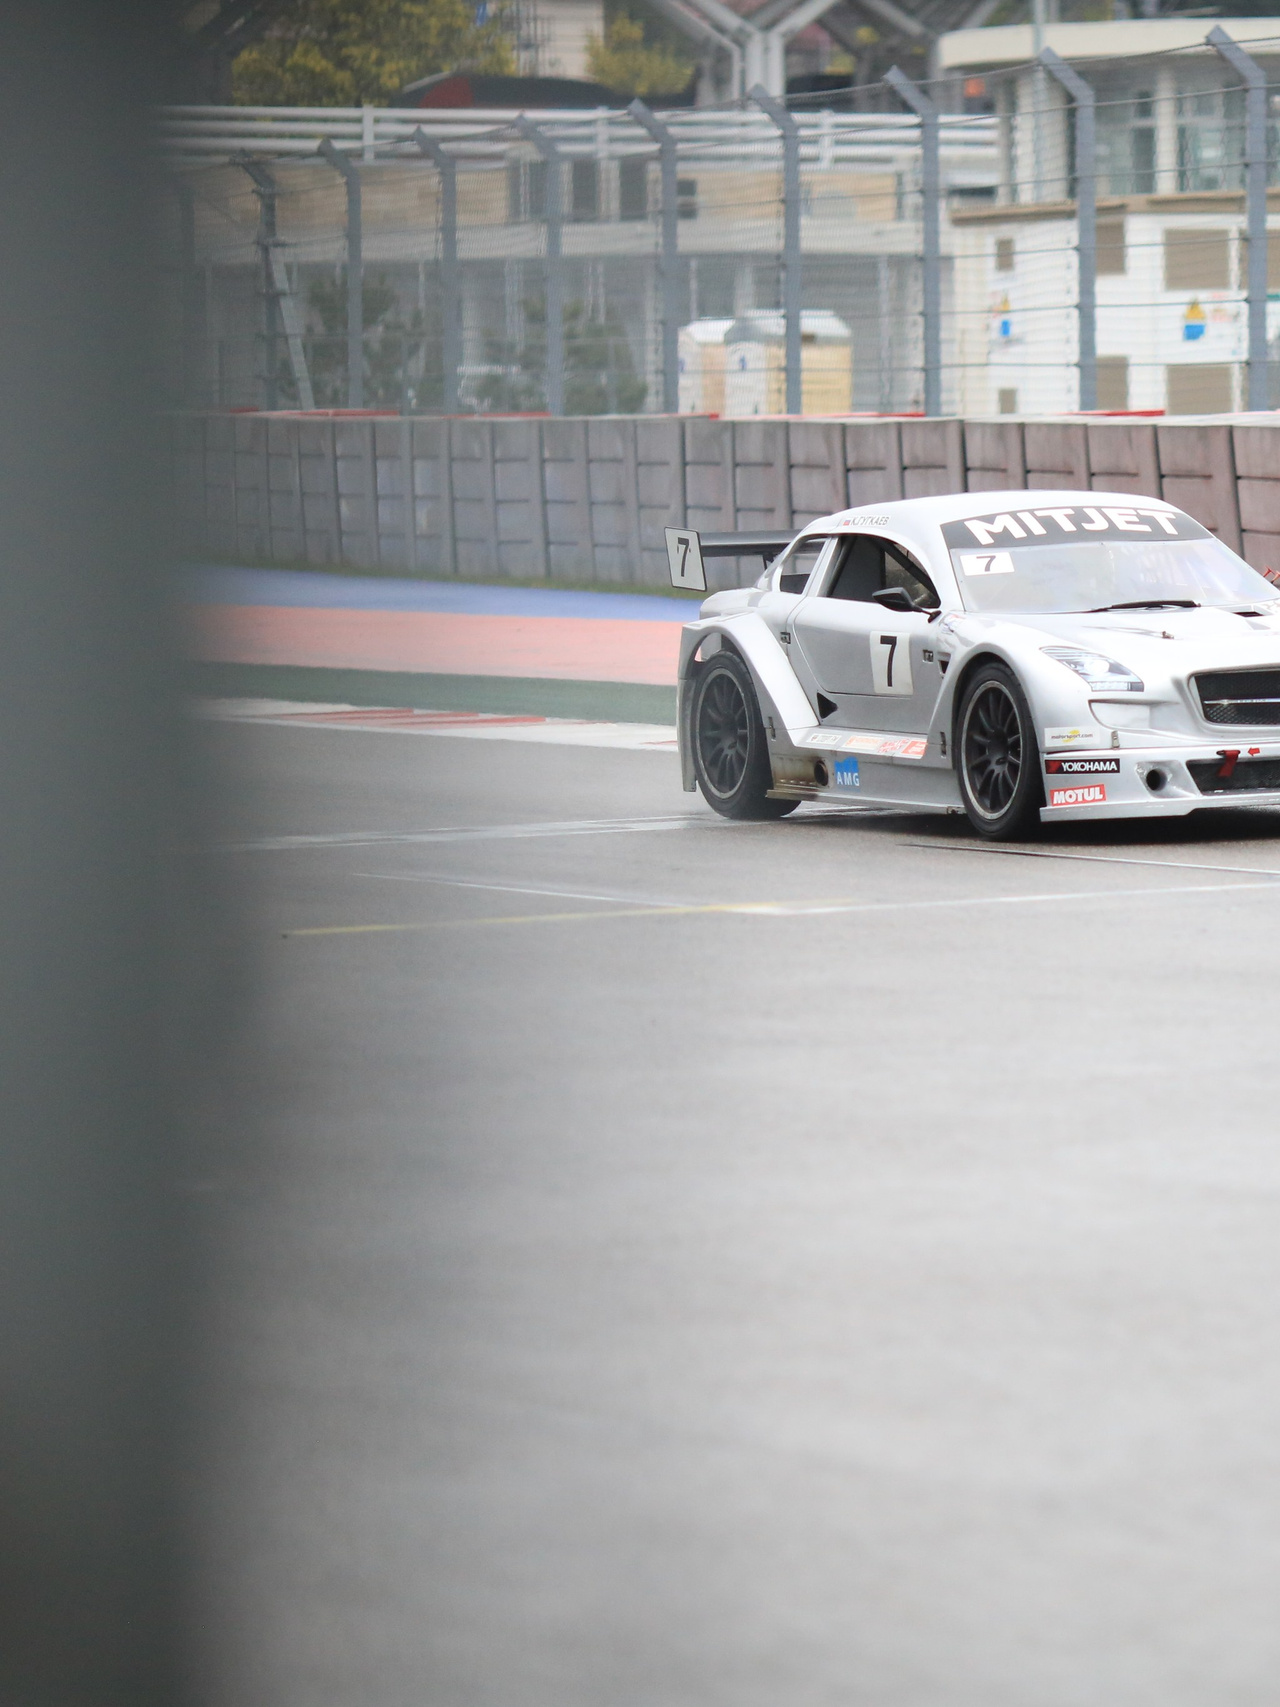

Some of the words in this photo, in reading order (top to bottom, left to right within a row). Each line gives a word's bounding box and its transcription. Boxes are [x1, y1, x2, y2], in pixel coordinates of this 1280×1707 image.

[964, 507, 1179, 545] MITJET
[677, 536, 690, 577] 7
[976, 555, 997, 572] 7
[880, 635, 897, 687] 7
[1061, 761, 1118, 772] YOKOHAMA
[836, 771, 860, 787] AMG
[1053, 786, 1104, 805] MOTUL
